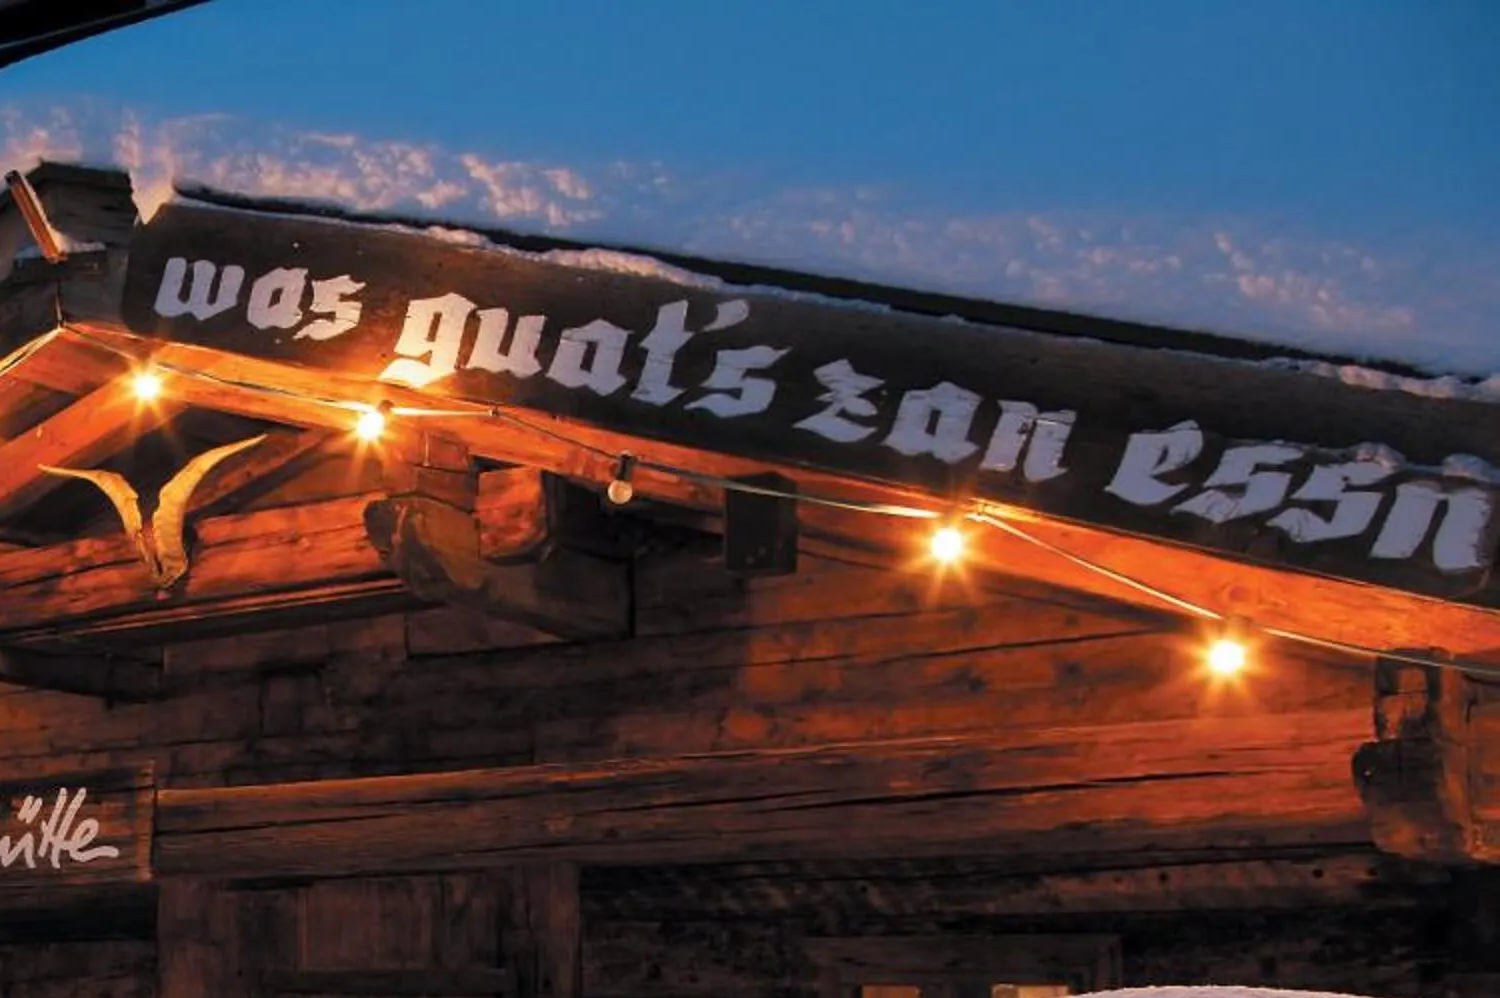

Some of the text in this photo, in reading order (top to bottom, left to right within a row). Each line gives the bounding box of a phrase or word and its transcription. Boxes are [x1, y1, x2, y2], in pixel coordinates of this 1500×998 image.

[152, 255, 1491, 573] was guat's zan essn
